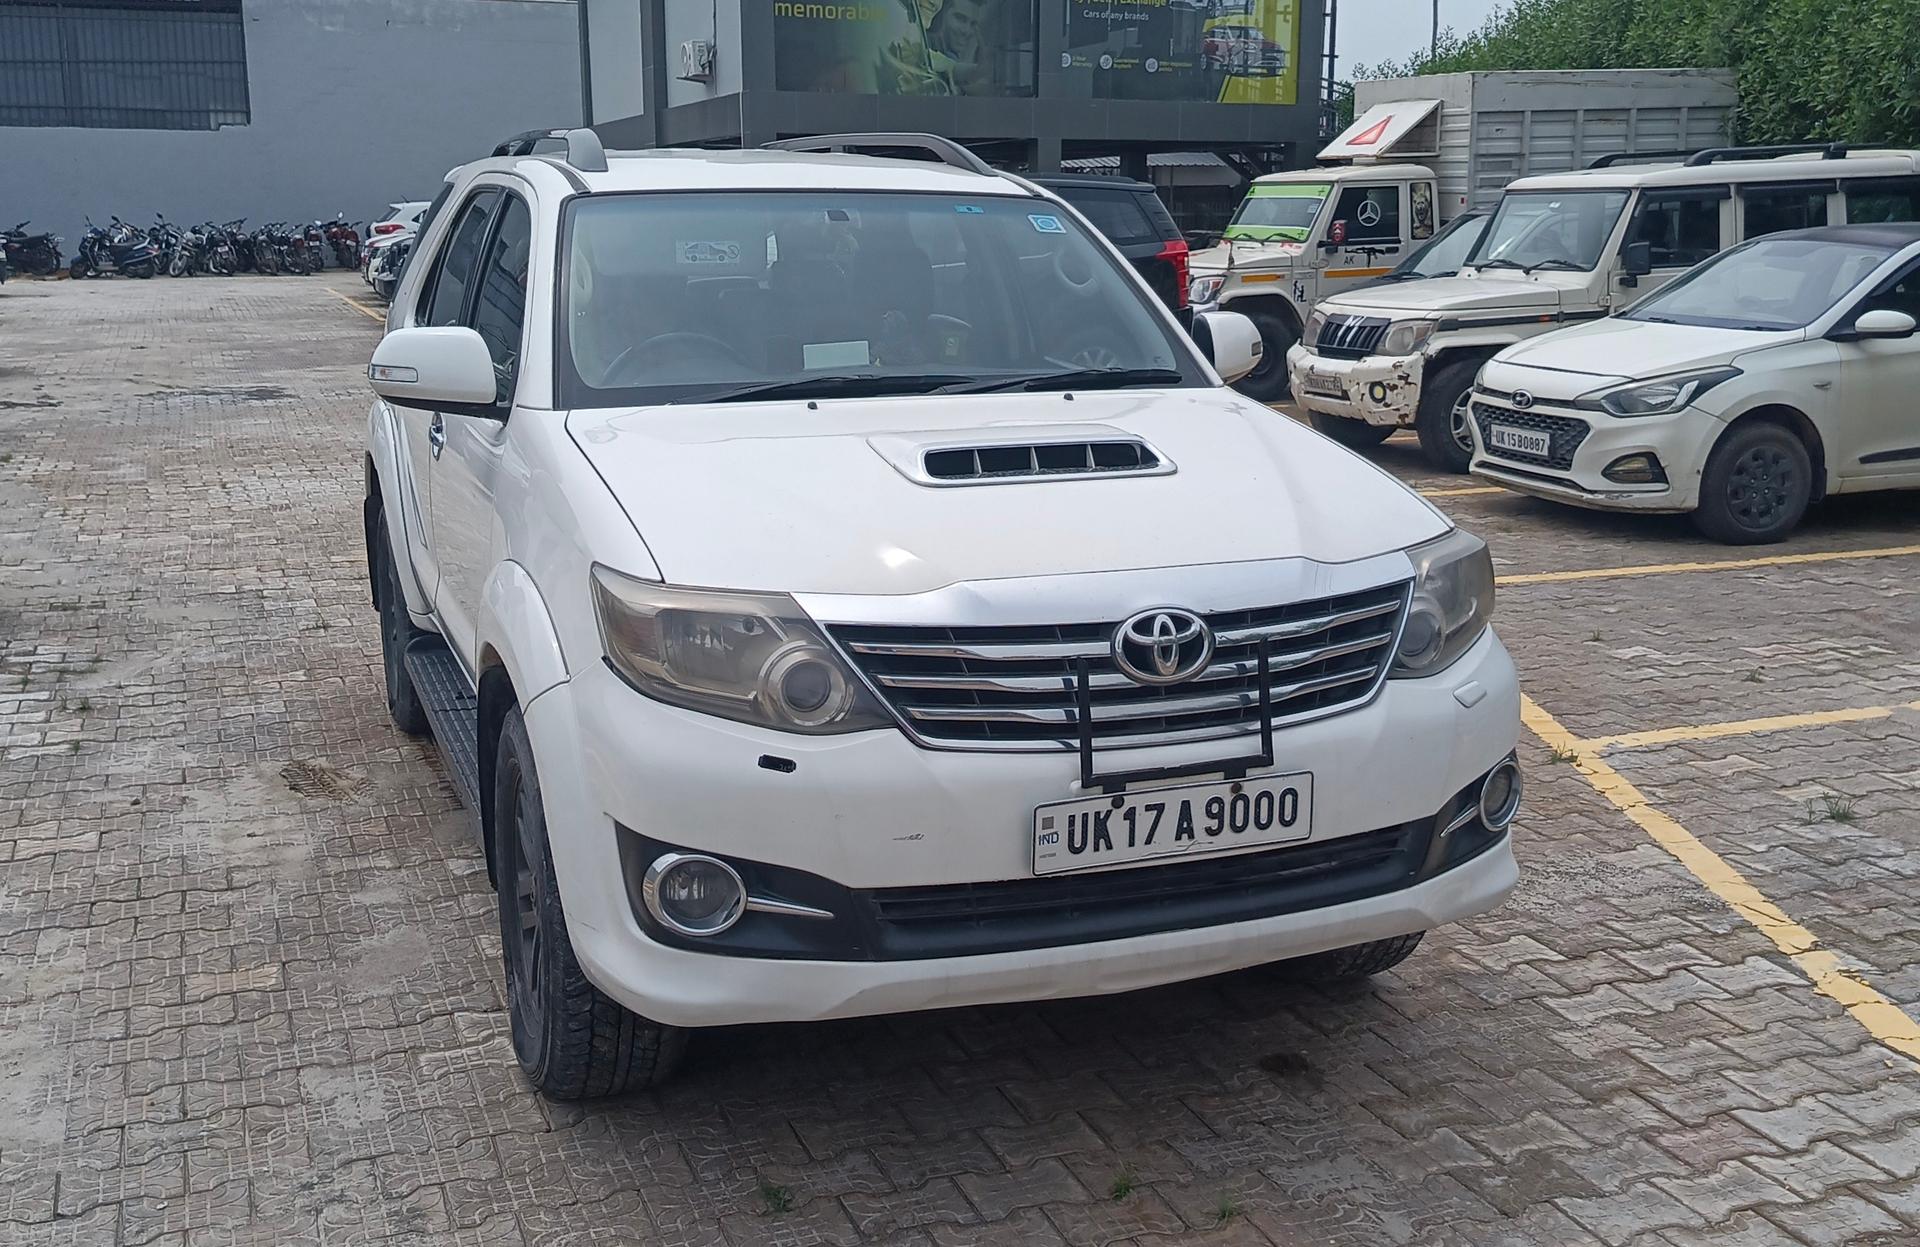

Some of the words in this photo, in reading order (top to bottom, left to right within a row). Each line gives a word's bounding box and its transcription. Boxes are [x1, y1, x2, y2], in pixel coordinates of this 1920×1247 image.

[774, 1, 886, 20] memorab
[1083, 10, 1100, 18] Cars
[1110, 12, 1123, 21] any
[1124, 11, 1149, 20] brands
[1344, 256, 1355, 265] AK
[1039, 831, 1060, 846] IND
